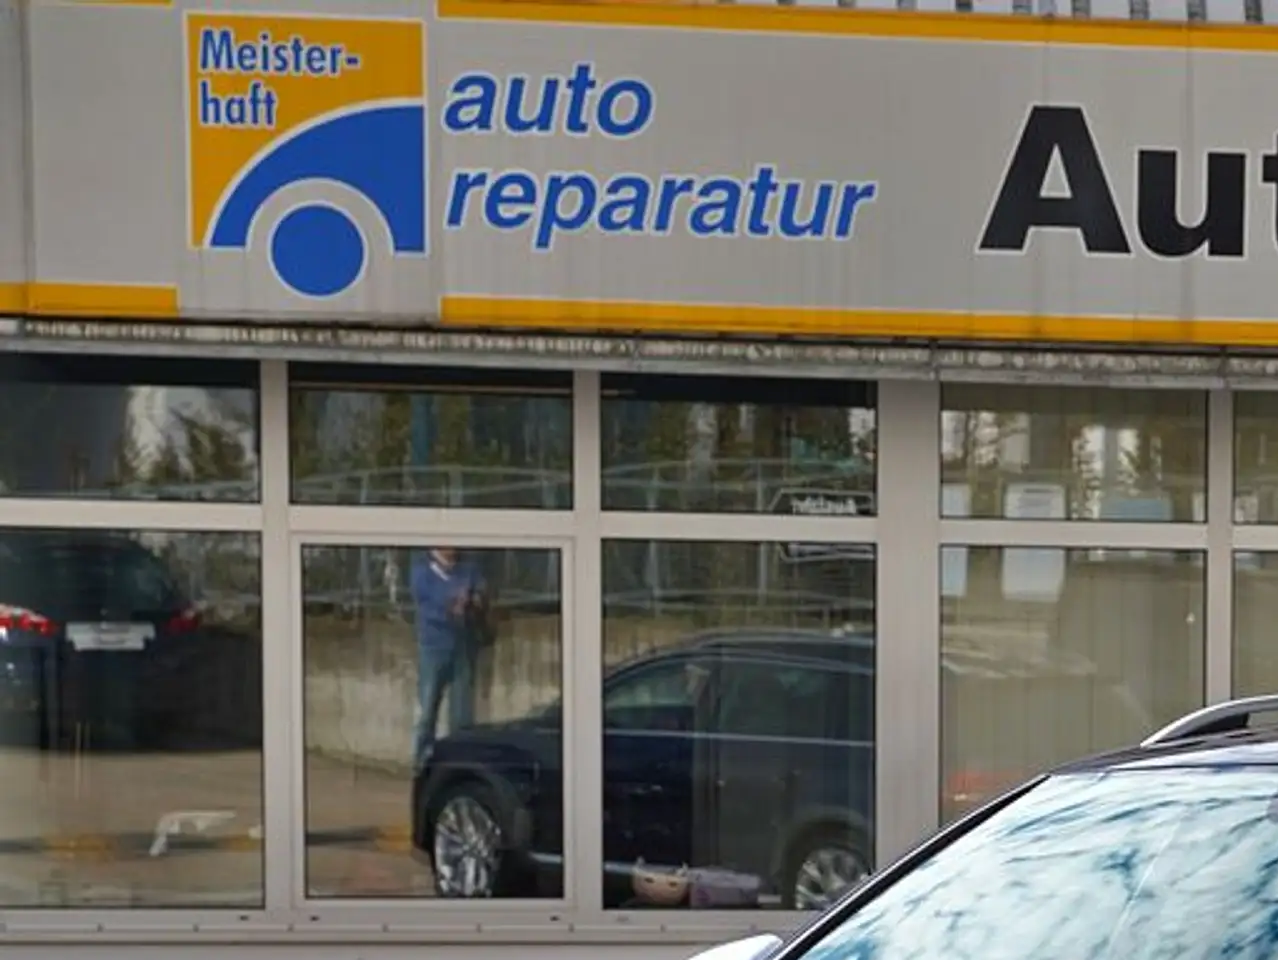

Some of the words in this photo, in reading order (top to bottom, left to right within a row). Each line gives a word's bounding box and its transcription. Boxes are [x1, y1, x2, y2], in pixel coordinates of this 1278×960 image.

[200, 28, 360, 75] Meister-
[200, 80, 276, 127] haft
[443, 63, 652, 137] auto
[445, 166, 877, 249] reparatur
